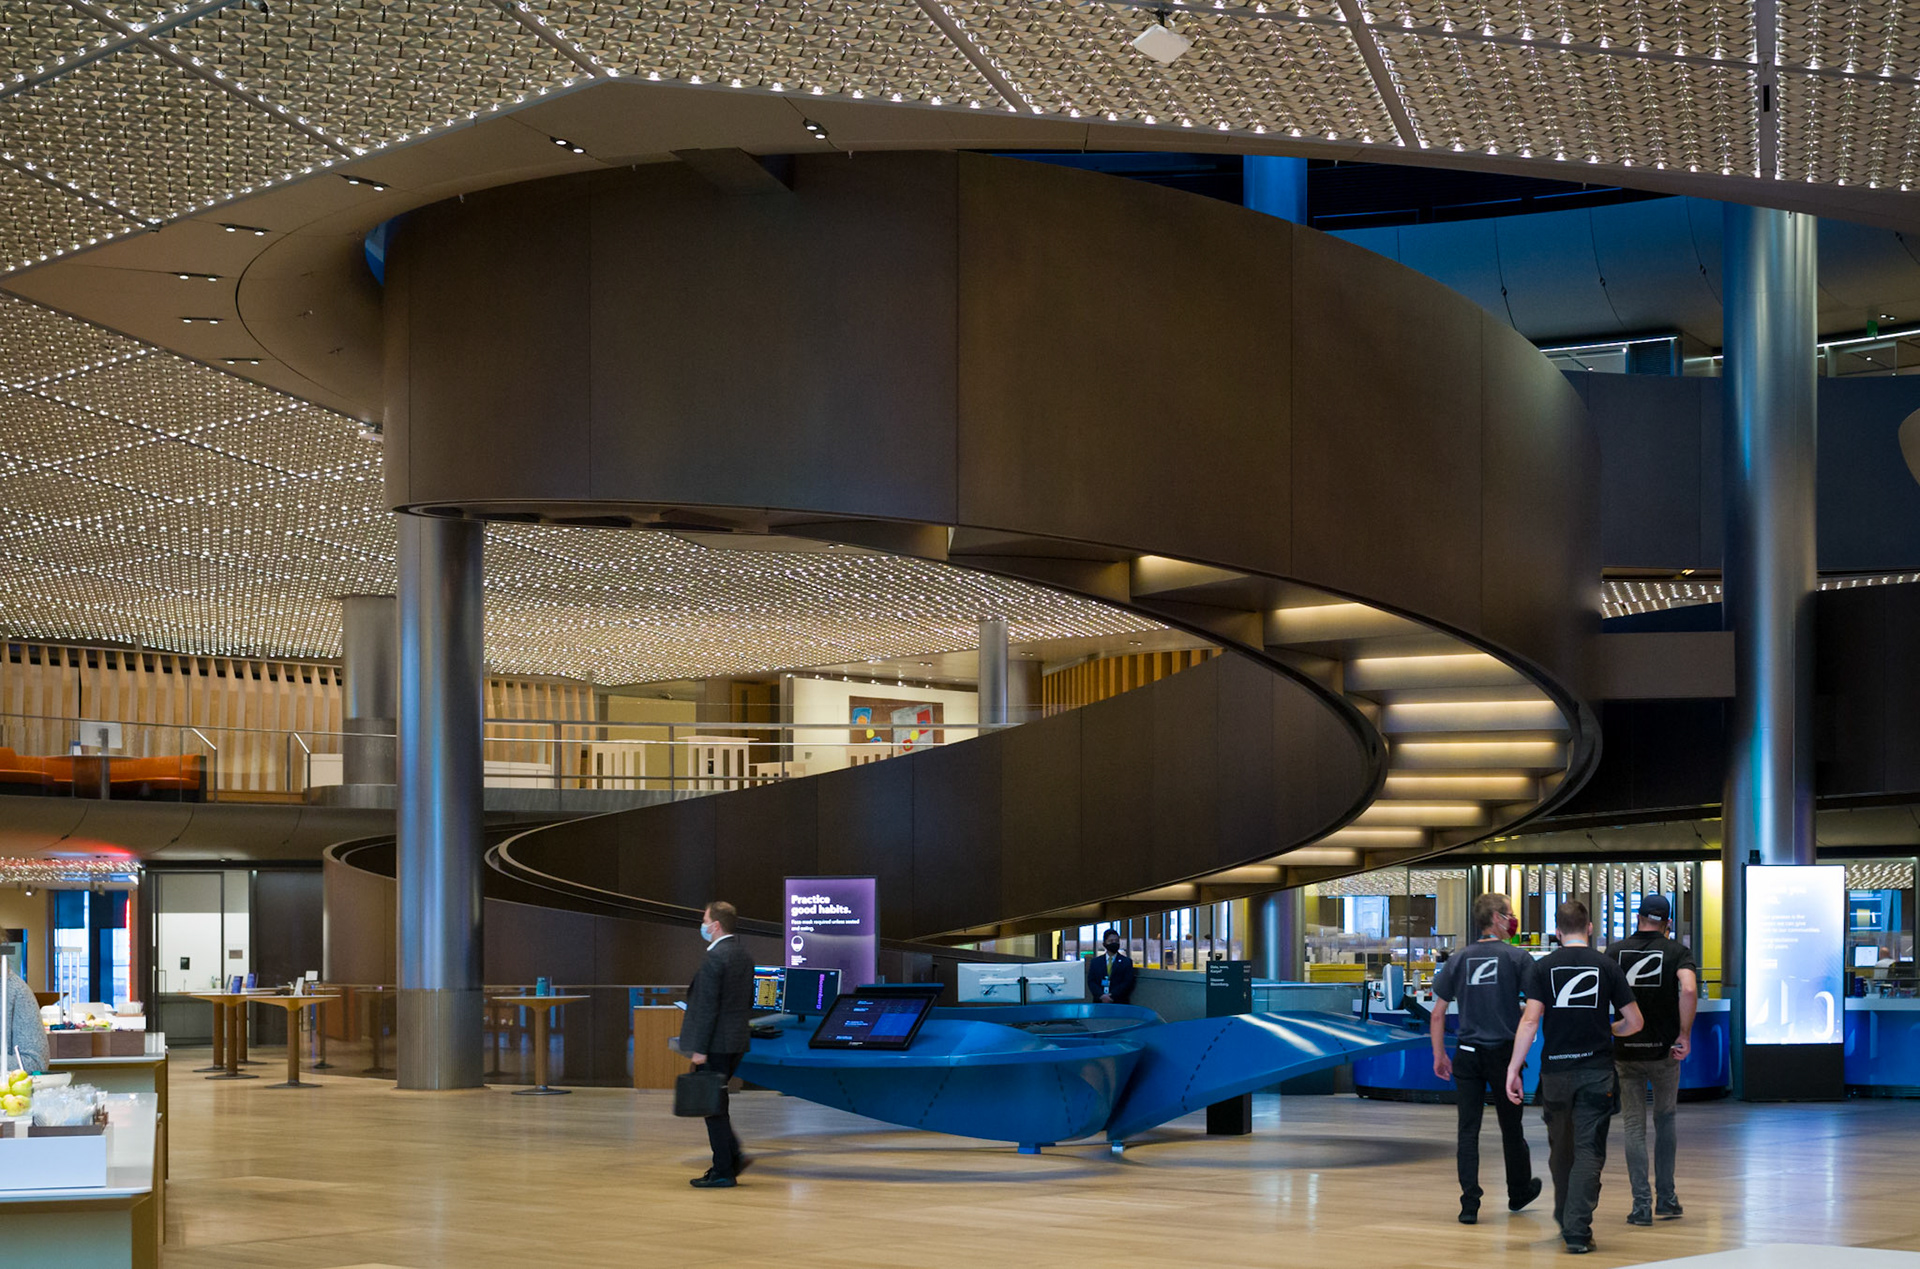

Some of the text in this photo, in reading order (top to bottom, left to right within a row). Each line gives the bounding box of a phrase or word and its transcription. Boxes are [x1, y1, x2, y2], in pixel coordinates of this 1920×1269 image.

[791, 894, 830, 904] Practice
[791, 904, 851, 917] good habits.
[816, 974, 825, 1010] Bloomberg
